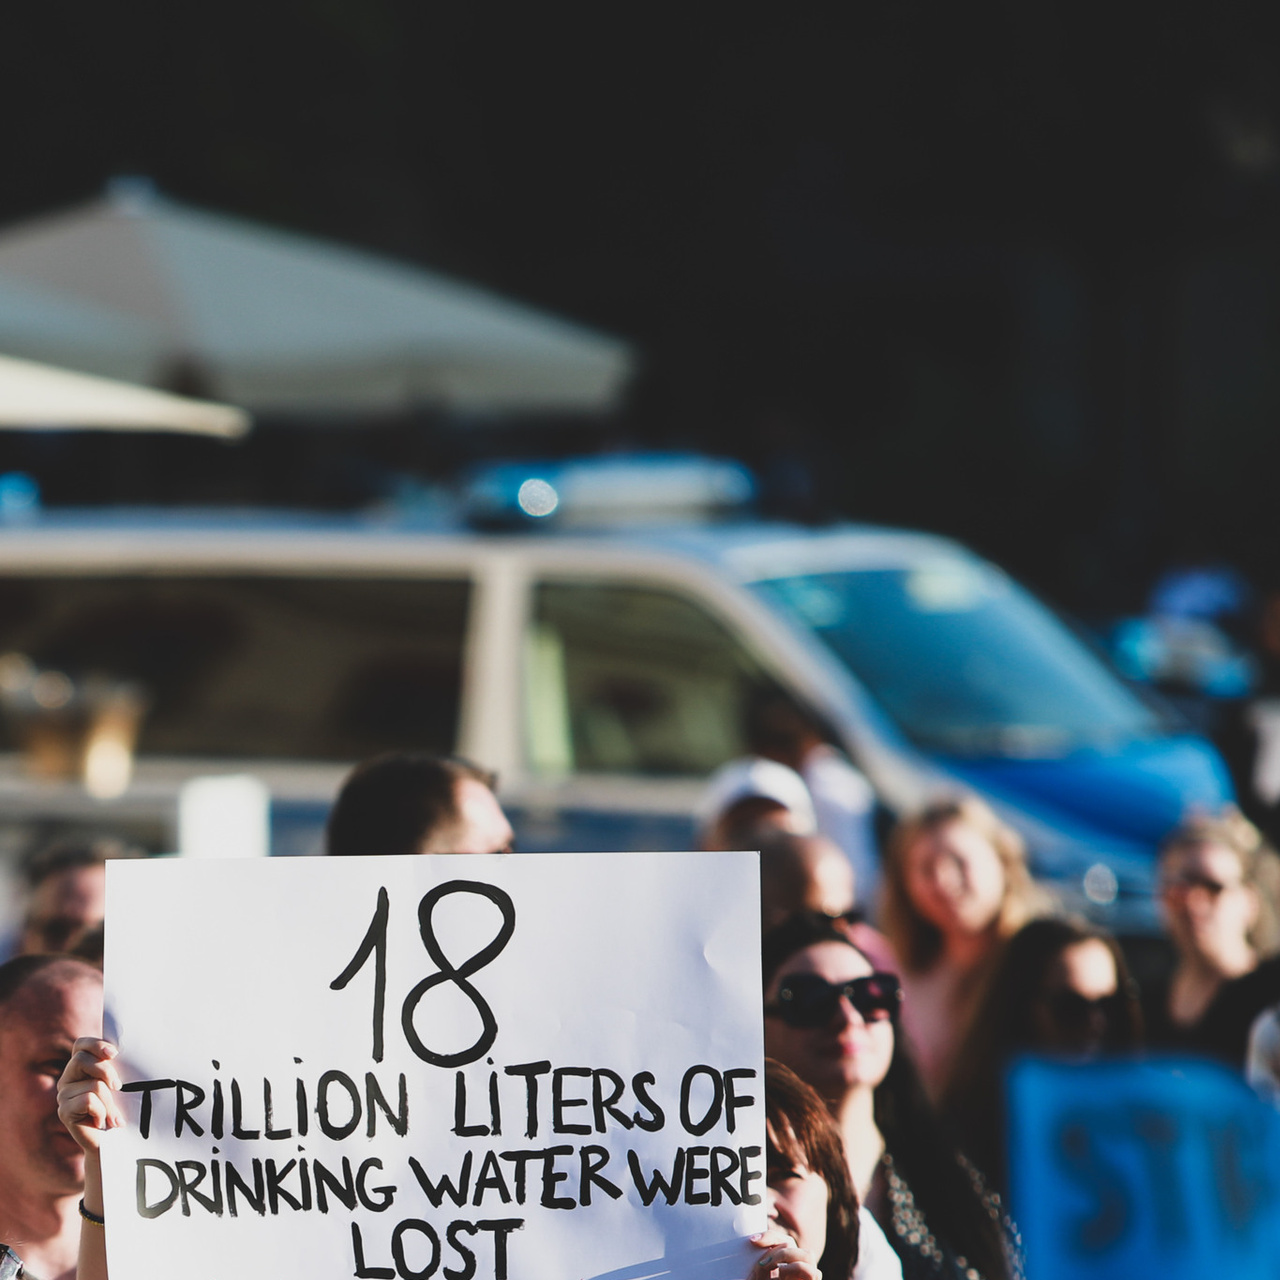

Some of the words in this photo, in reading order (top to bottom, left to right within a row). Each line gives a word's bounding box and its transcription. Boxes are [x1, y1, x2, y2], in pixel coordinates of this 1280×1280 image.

[329, 879, 516, 1068] 18
[679, 1064, 757, 1137] OF
[408, 1145, 624, 1210] WATER
[626, 1145, 763, 1207] WERE
